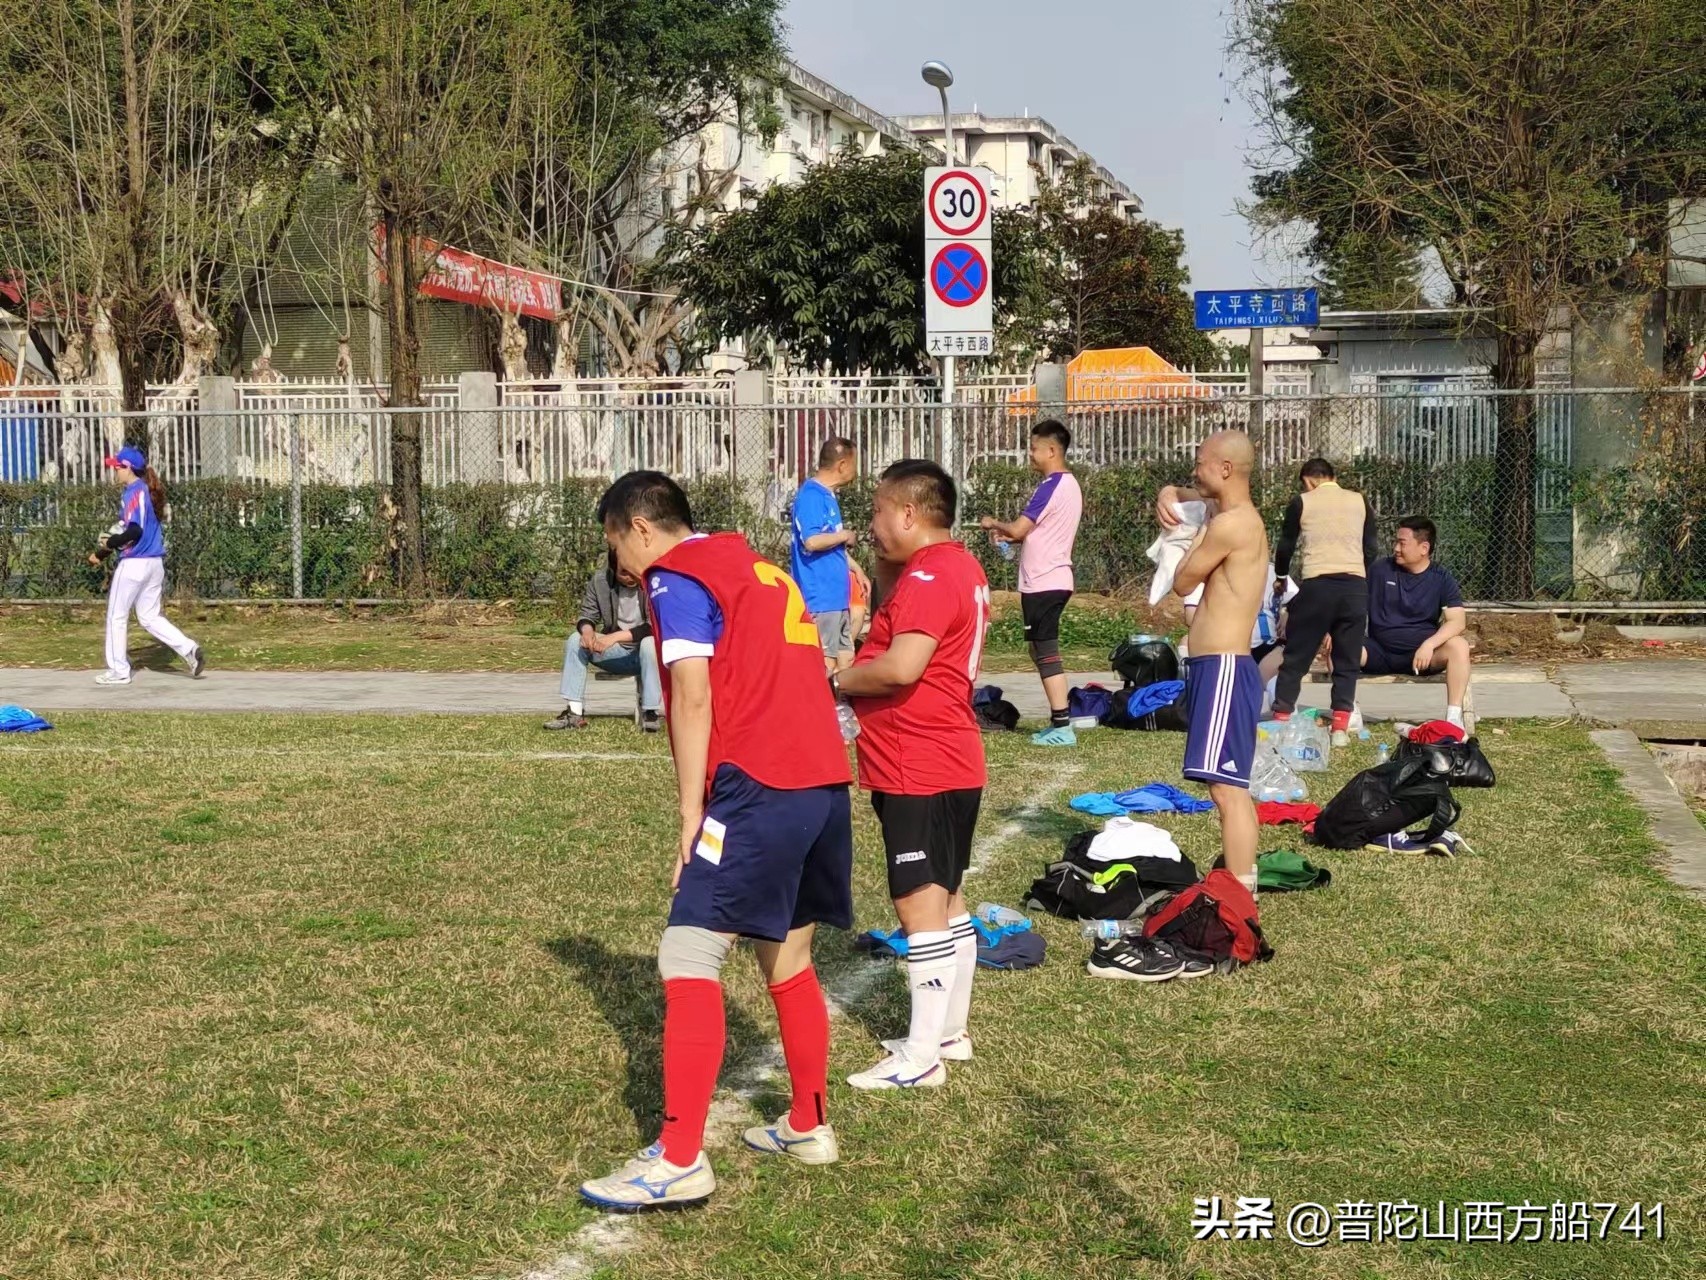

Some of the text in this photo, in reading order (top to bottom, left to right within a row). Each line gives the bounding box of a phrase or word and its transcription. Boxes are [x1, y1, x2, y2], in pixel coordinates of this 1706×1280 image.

[942, 188, 976, 218] 30
[1207, 293, 1306, 315] 太平寺西路
[1215, 316, 1256, 326] TAIPINGSI
[1259, 315, 1278, 324] XILU
[930, 336, 989, 352] 太平寺西路
[753, 561, 820, 648] 2
